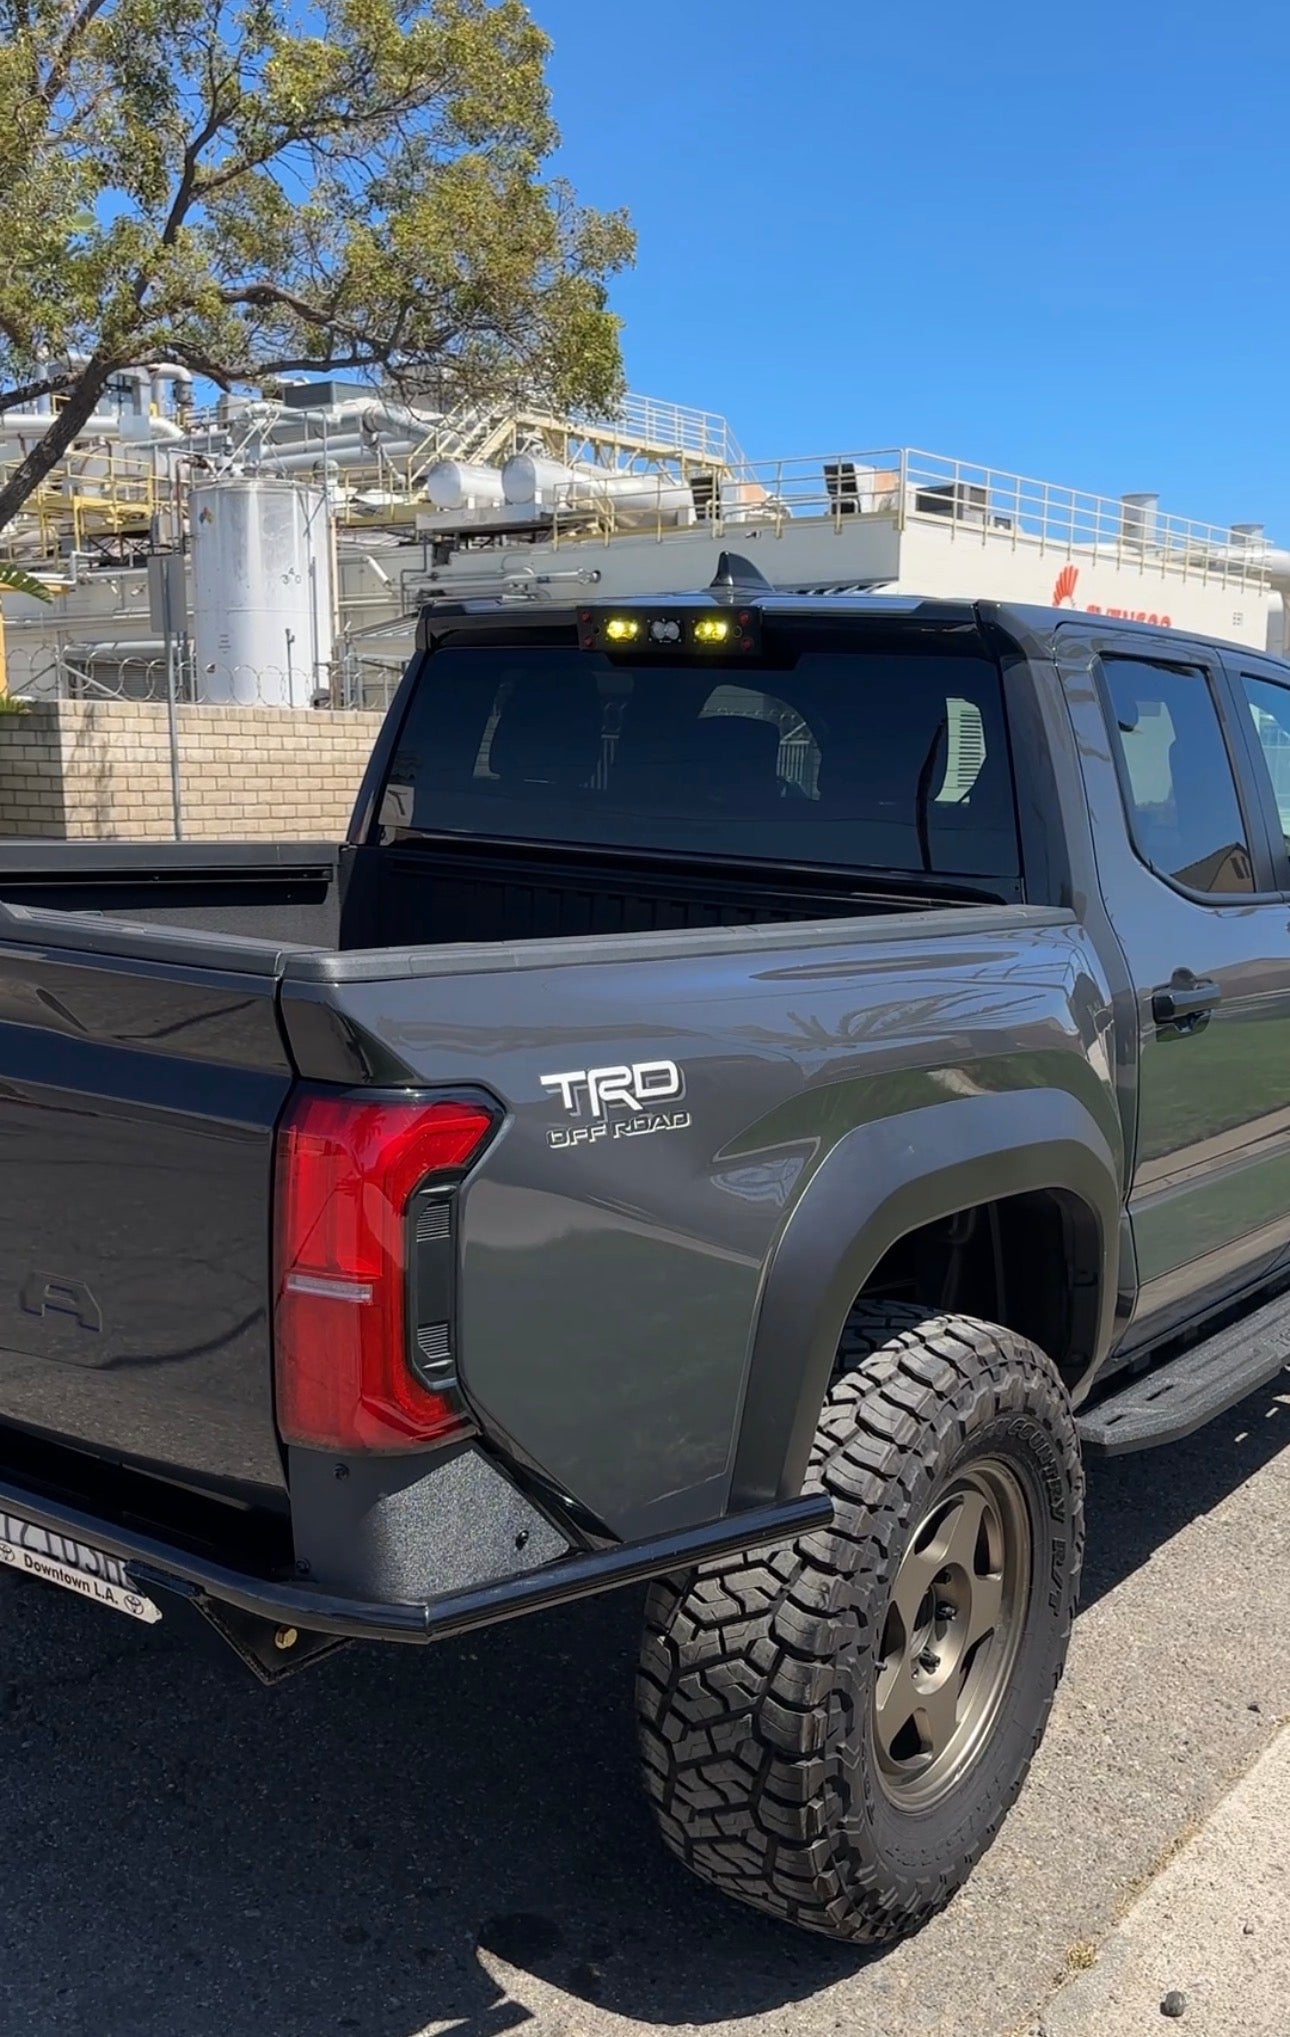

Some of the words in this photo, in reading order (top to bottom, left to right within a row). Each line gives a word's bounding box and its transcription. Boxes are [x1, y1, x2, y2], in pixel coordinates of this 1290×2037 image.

[540, 1060, 682, 1117] TRD
[547, 1124, 607, 1148] OFF
[612, 1111, 691, 1138] ROAD
[1008, 1417, 1065, 1524] COUNTRY
[23, 1553, 91, 1593] Downtown
[94, 1581, 119, 1605] L.A.
